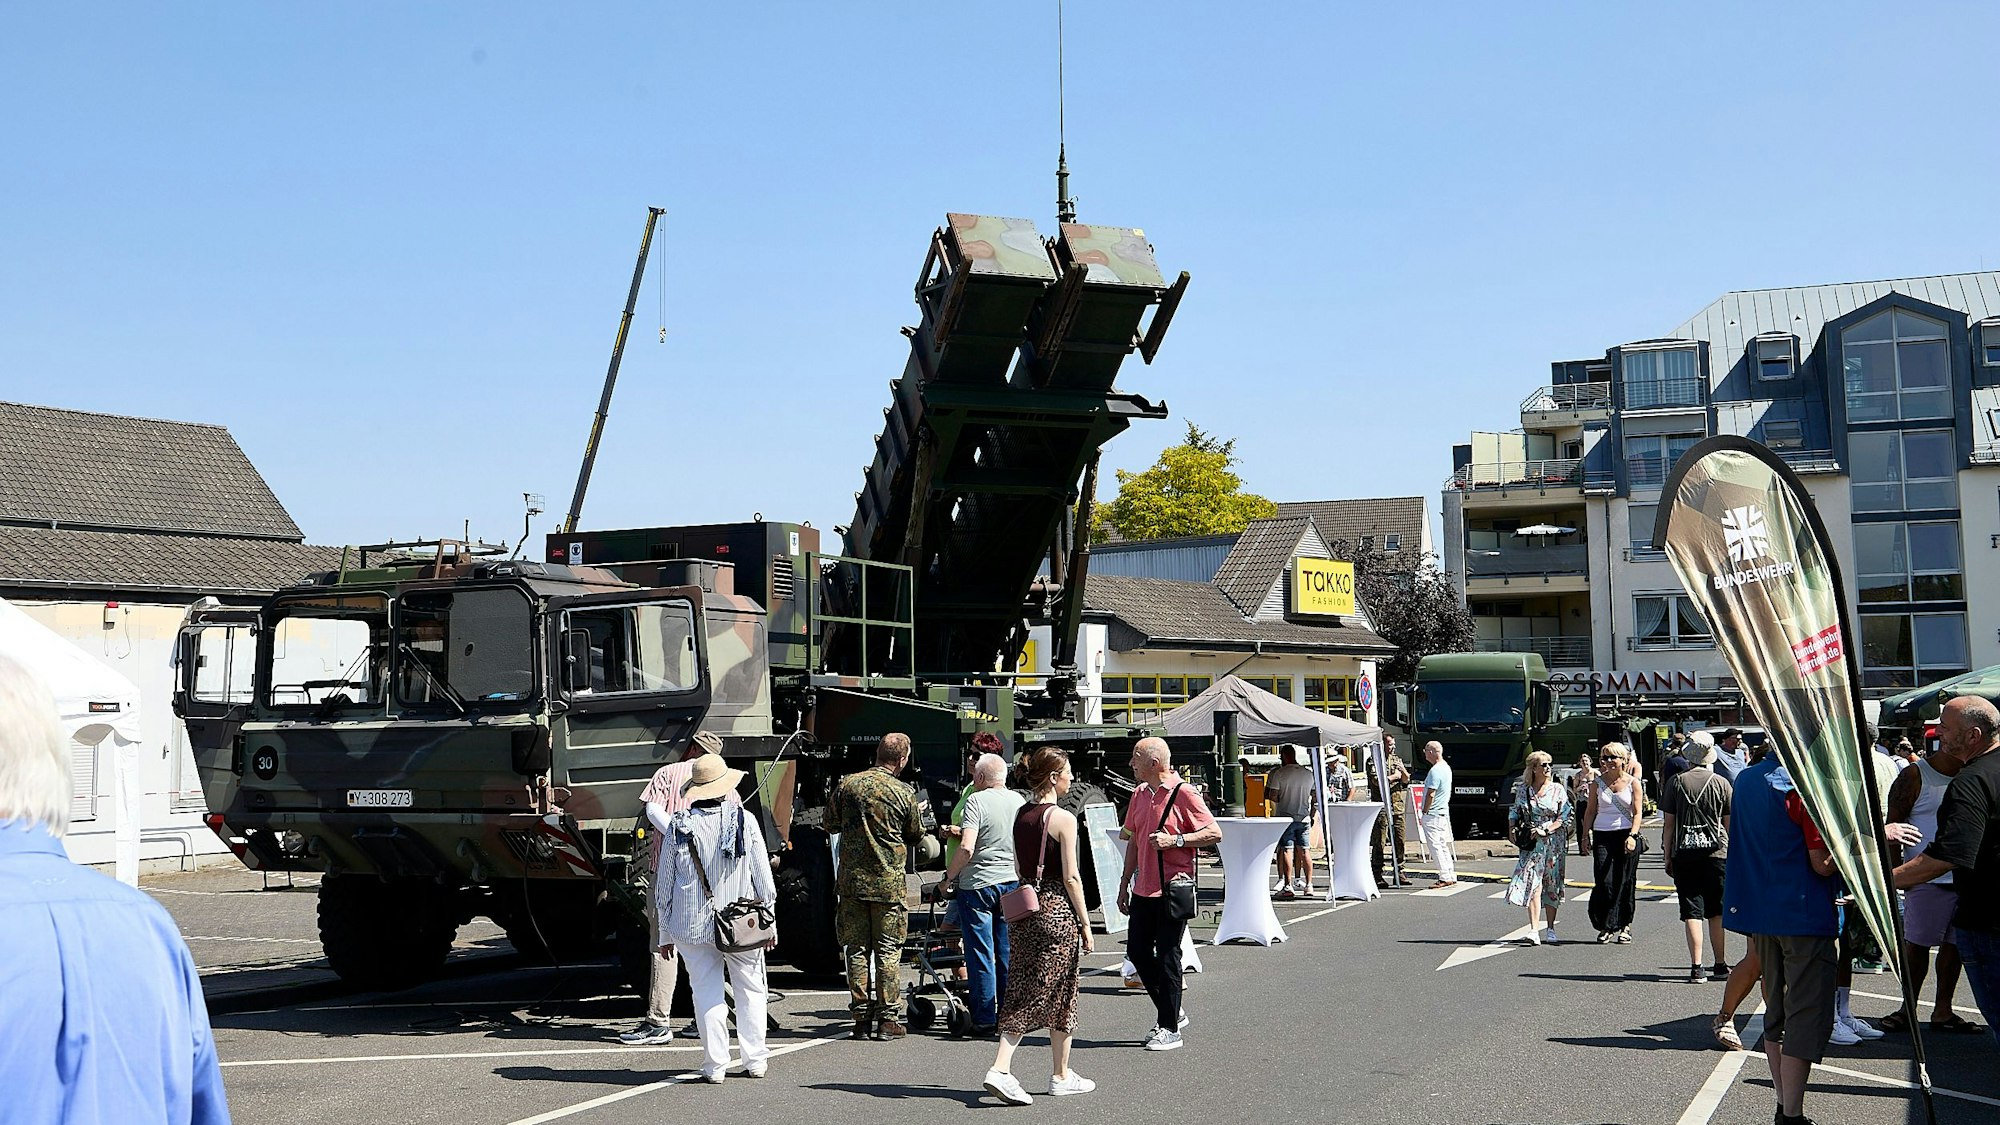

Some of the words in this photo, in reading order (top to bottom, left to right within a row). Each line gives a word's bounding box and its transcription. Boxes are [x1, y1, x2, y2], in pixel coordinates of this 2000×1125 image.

[1713, 562, 1794, 590] BUNDESWEHR
[1313, 596, 1346, 606] FASHION
[1794, 631, 1839, 659] bundeswehr
[1800, 647, 1840, 673] karriere.de
[1550, 671, 1696, 692] OSSMANN
[258, 756, 273, 770] 30
[391, 792, 411, 805] 273
